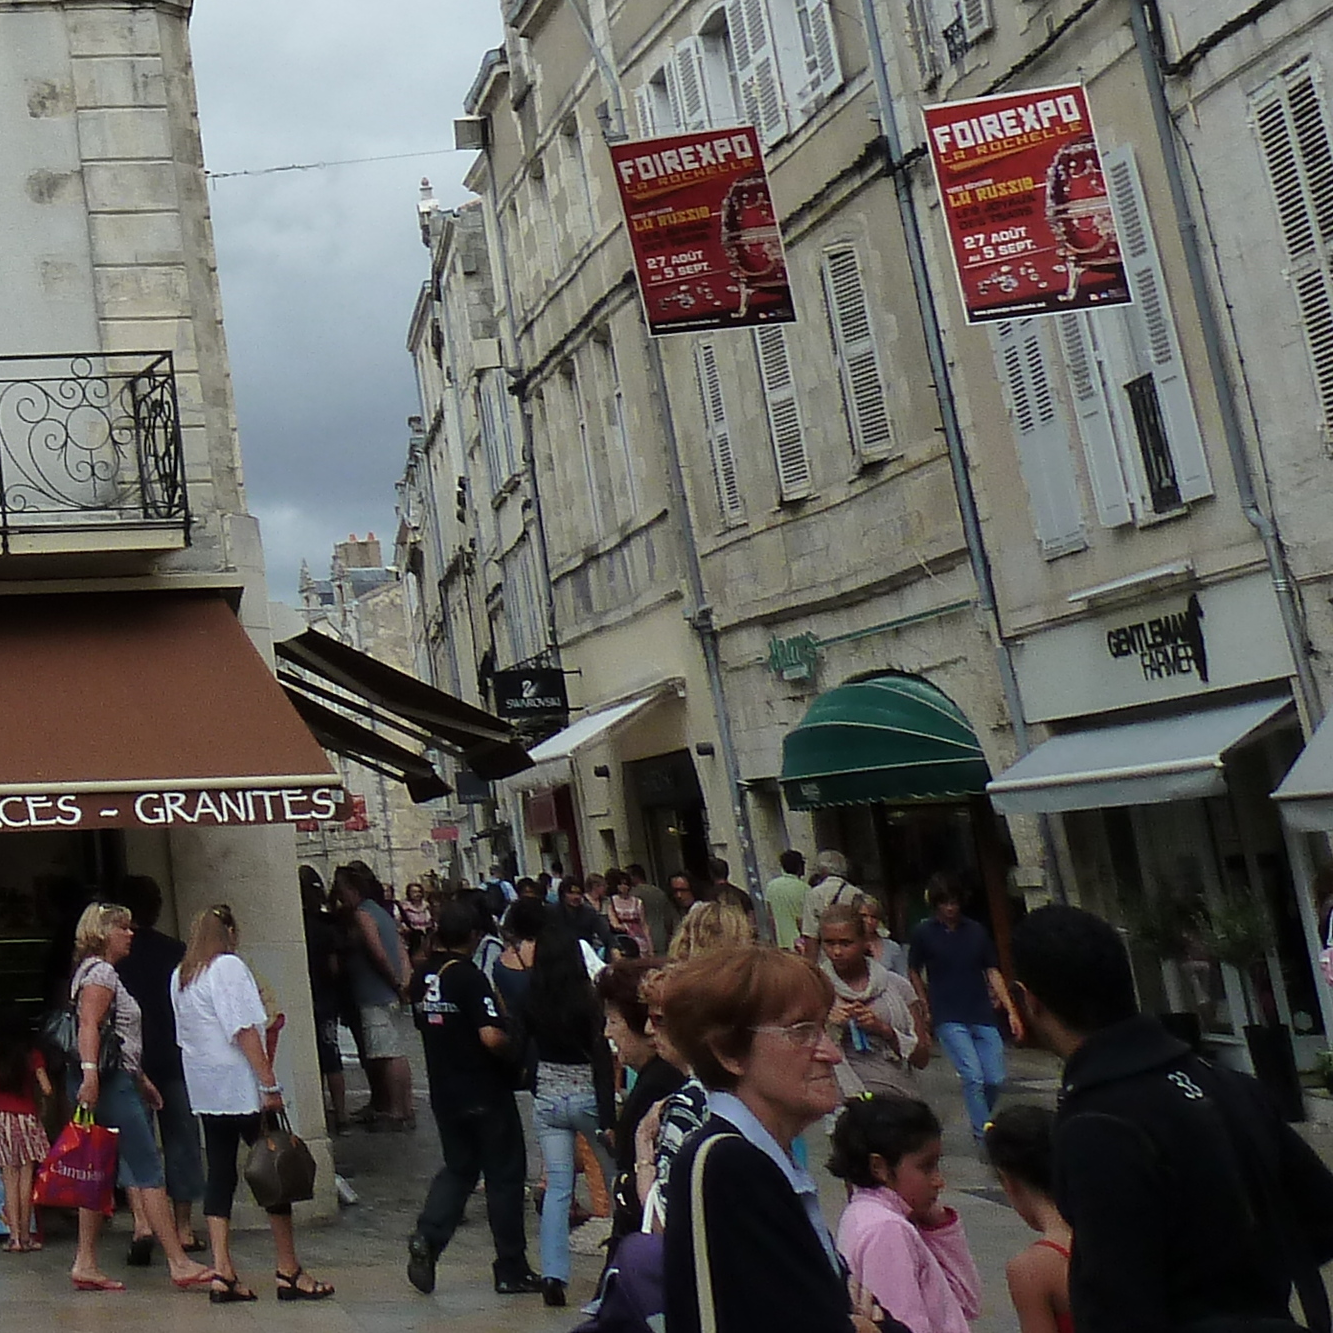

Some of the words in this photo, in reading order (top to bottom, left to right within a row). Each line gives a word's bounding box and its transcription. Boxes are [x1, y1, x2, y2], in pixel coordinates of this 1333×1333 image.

[933, 94, 1082, 154] FOIREXPO
[940, 150, 966, 164] LA
[976, 121, 1083, 155] ROCHELLE
[617, 133, 754, 184] FOIREXPO
[625, 182, 648, 193] LA
[658, 158, 755, 186] ROCHELLE
[963, 234, 985, 249] 27
[991, 226, 1028, 244] AOÛT
[983, 245, 995, 259] 5
[998, 239, 1037, 256] SEPT.
[646, 256, 666, 270] 27
[671, 250, 704, 266] AOÛT
[663, 267, 675, 278] 5
[677, 262, 712, 276] SEPT.
[505, 697, 561, 709] SWAROVSKI
[133, 787, 337, 825] GRANITES
[424, 973, 442, 1002] 3
